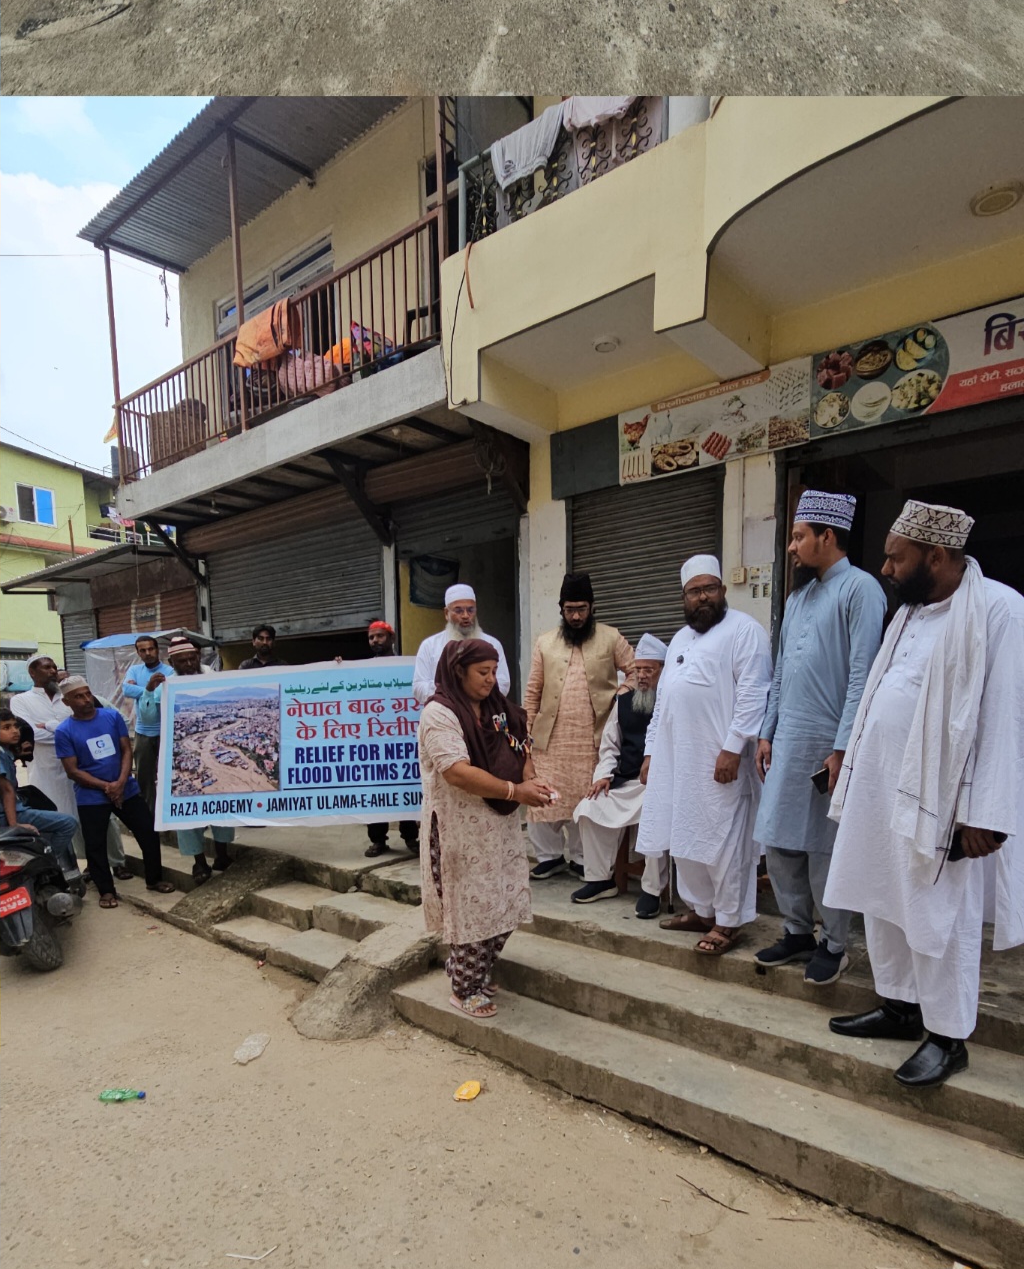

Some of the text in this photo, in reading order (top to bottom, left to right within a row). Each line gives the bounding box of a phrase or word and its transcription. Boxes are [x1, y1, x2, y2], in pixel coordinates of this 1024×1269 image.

[286, 698, 342, 717] नेपाल
[347, 698, 385, 716] बाढ़
[296, 721, 317, 740] के
[323, 719, 361, 739] लिए
[295, 745, 345, 764] RELIEF
[349, 744, 380, 762] FOR
[288, 762, 421, 784] FLOOD VICTIMS 20
[170, 802, 198, 817] RAZA
[202, 798, 253, 815] ACADEMY
[266, 796, 313, 812] JAMIYAT
[317, 793, 400, 810] ULAMA-E-AHLE
